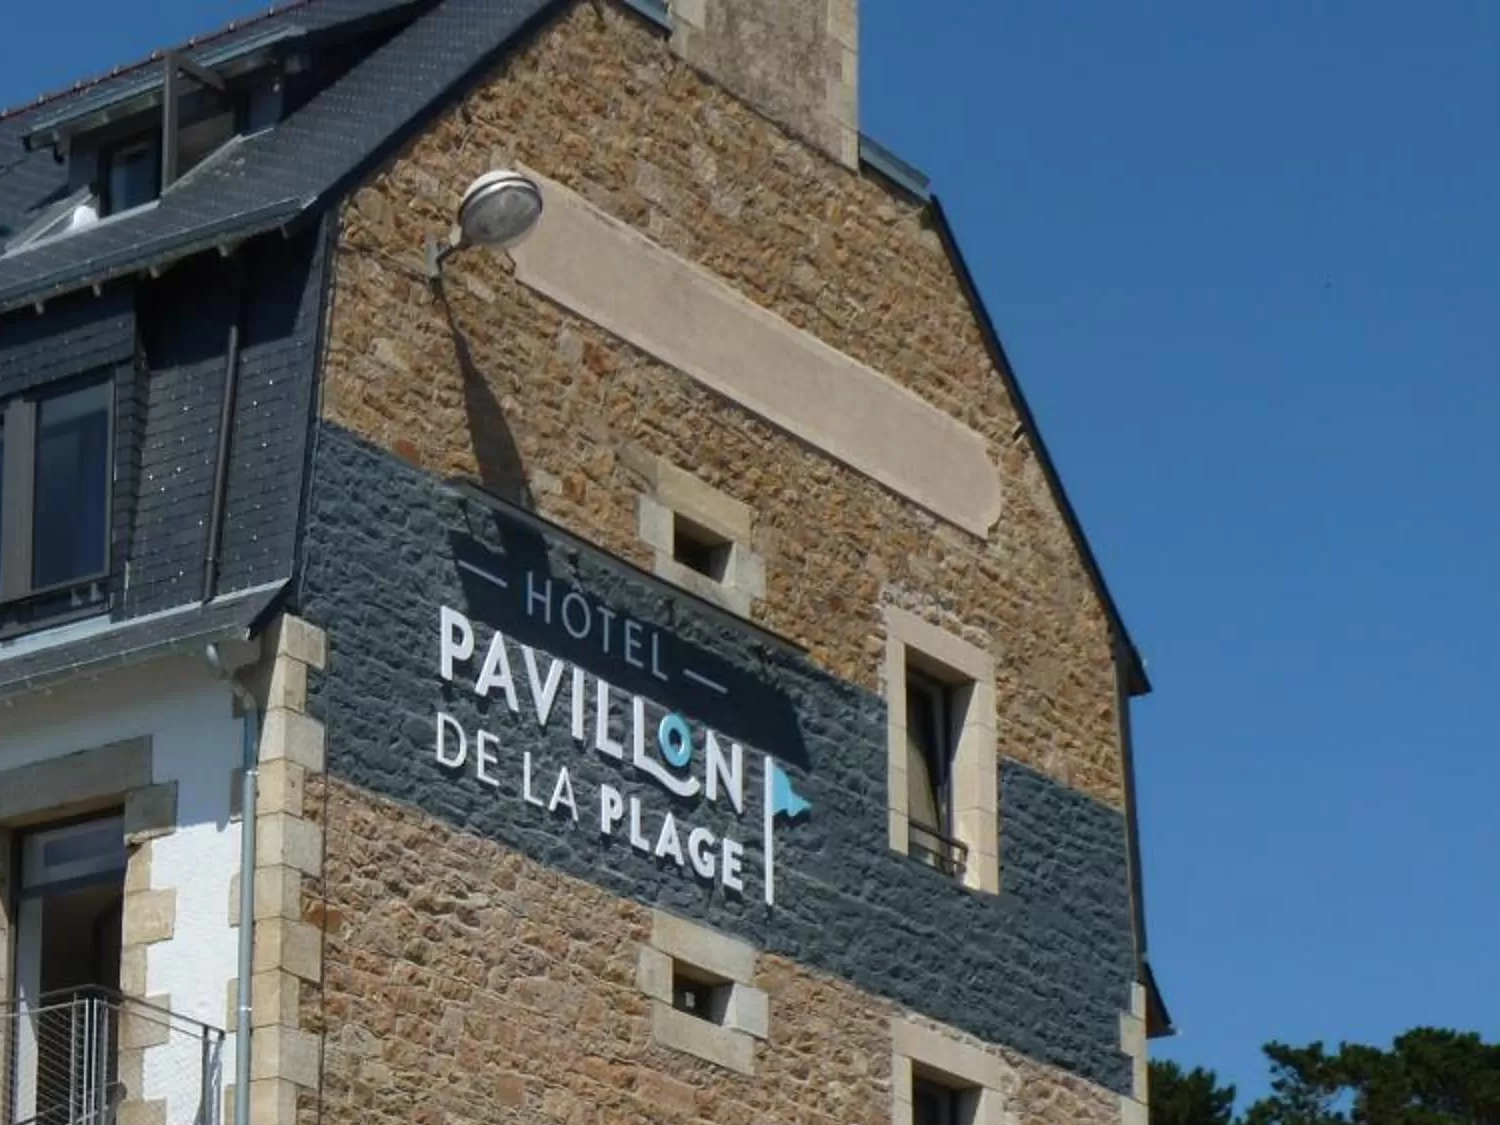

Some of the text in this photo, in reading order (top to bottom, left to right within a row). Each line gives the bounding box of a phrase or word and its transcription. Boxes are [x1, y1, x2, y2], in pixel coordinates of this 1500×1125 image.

[440, 605, 744, 815] PAVILLON
[526, 571, 668, 681] HÔTEL
[436, 711, 744, 892] DE LA PLAGE
